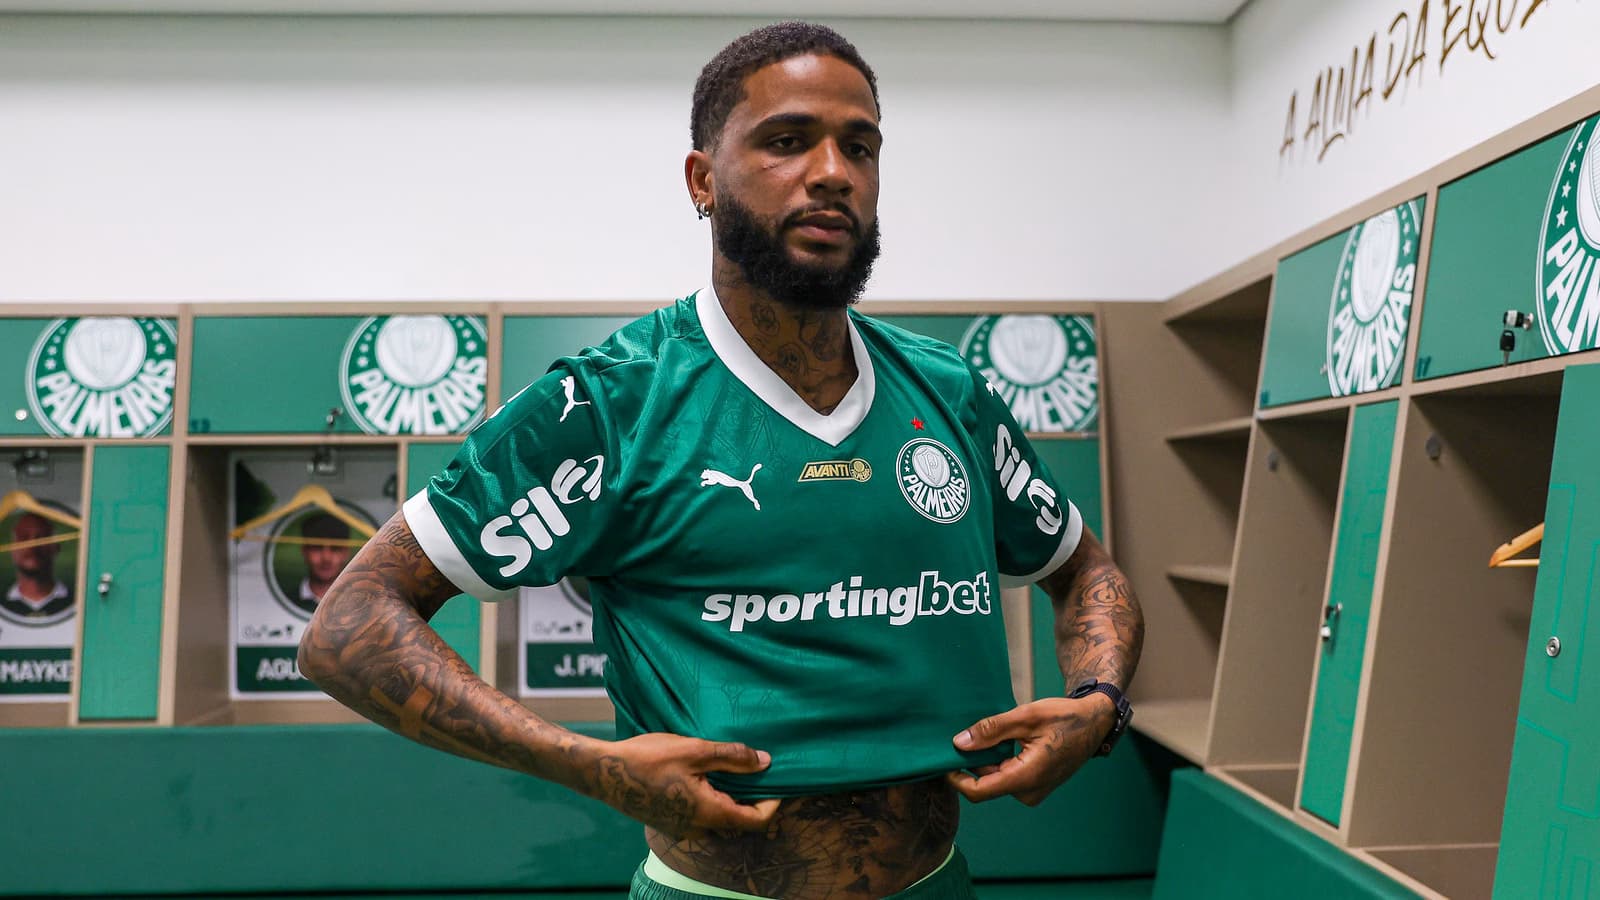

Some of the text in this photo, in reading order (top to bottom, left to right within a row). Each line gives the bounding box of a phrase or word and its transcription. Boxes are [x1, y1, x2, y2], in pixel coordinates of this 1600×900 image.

[1279, 90, 1297, 158] A
[1303, 32, 1377, 163] ALMA
[1382, 0, 1429, 100] DA
[1334, 263, 1416, 395] PALMEIRAS
[36, 358, 176, 437] PALMEIRAS
[350, 355, 487, 435] PALMEIRAS
[805, 463, 849, 478] AVANTI
[903, 474, 966, 519] PALMEIRAS
[701, 570, 991, 632] sportingbet
